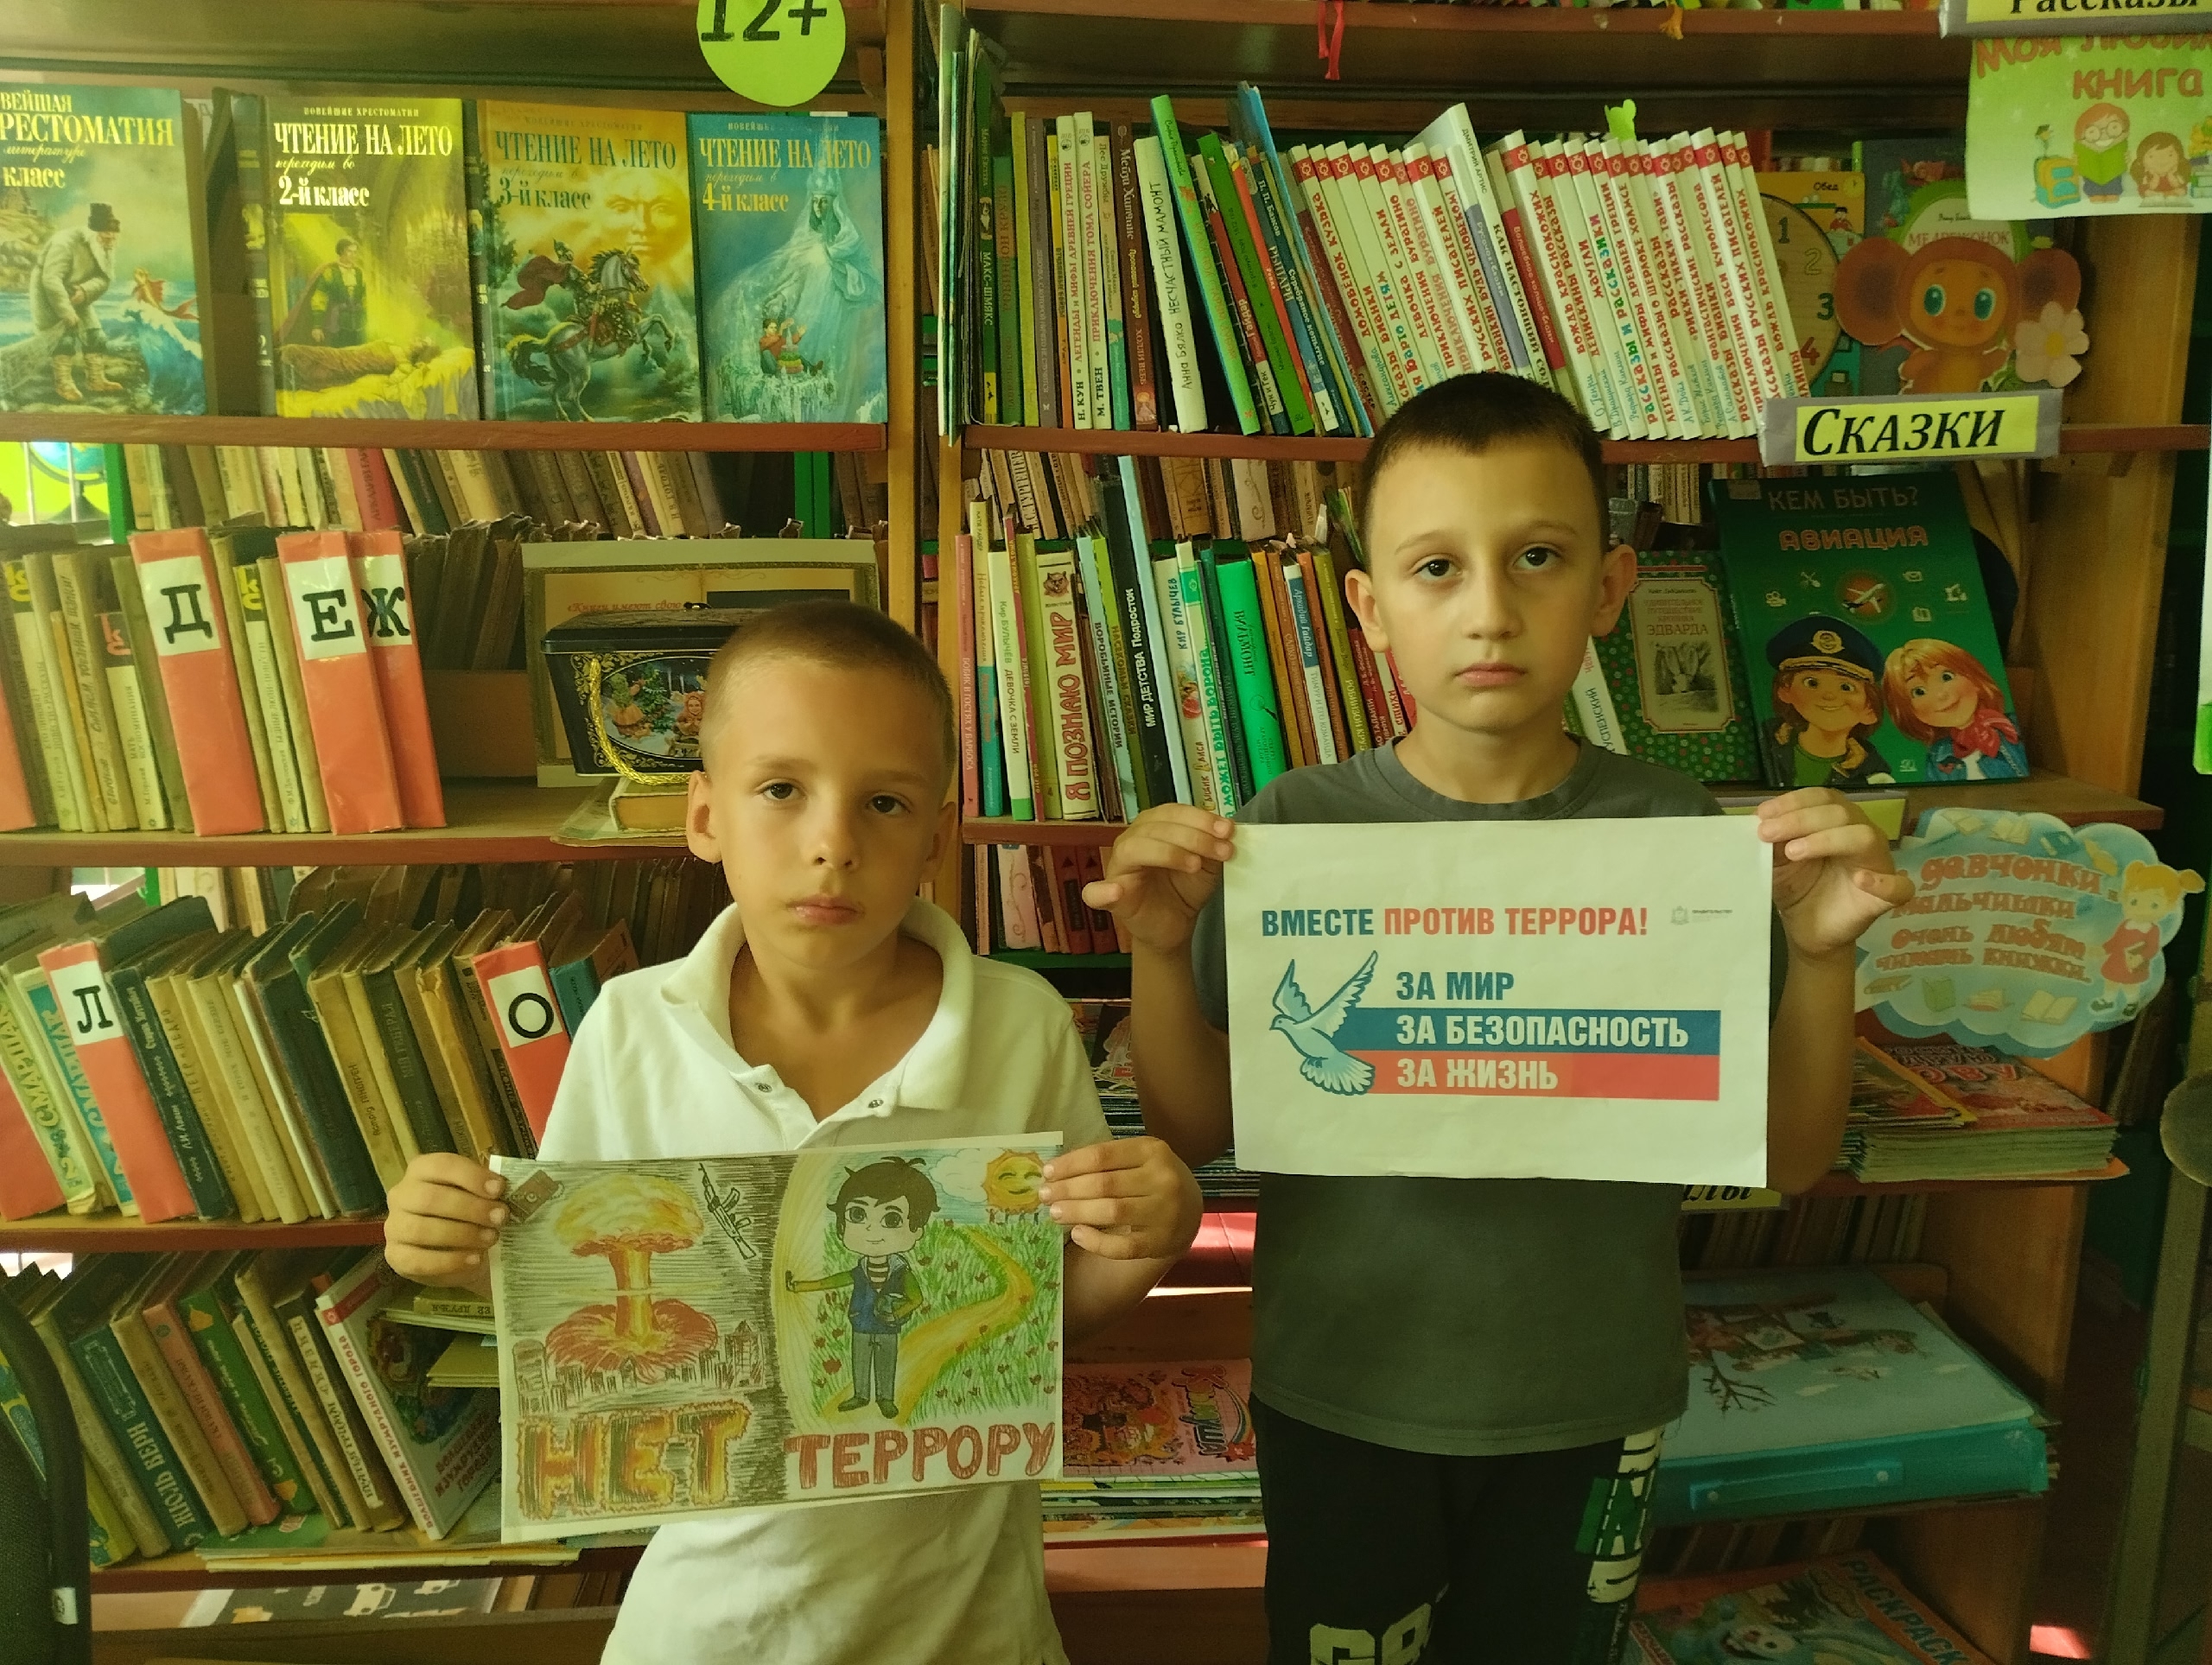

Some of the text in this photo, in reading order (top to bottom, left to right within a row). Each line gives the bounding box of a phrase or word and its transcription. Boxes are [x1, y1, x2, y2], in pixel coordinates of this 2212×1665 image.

[701, 0, 828, 41] 12+
[0, 89, 72, 112] ВЕЙШАЯ
[0, 112, 174, 146] РЕСТОМАТИЯ
[274, 123, 452, 156] ЧТЕНИЕ НА ЛЕТО
[496, 131, 676, 169] ЧТЕНИЕ НА ЛЕТО
[699, 137, 871, 168] ЧТЕНИЕ НА ЛЕТО
[1461, 127, 1480, 166] ДМИТРИЙ
[3, 167, 65, 187] класс
[279, 175, 369, 207] 2-й класс
[499, 176, 590, 210] 3-й класс
[702, 182, 789, 213] 4-й класс
[1813, 181, 1840, 191] Обед
[1265, 204, 1282, 236] Бажов
[1692, 181, 1724, 266] КУРОЛЕСОВА
[1777, 217, 1791, 245] 1
[1528, 188, 1586, 355] ВОЖДЬ КРАСНОКОЖИХ
[1577, 238, 1604, 301] МАУГЛИ
[1665, 179, 1722, 360] ФАНТАСТИЧЕСКИЕ РАССКАЗЫ
[1709, 173, 1761, 327] РУССКИХ ПИСАТЕЛЕЙ
[1735, 188, 1784, 352] ВОЖДЬ КРАСНОКОЖИХ
[1803, 247, 1823, 276] 2
[982, 251, 993, 326] МАКС-ШМЯКС
[1063, 162, 1084, 405] КУН ЛЕГЕНДЫ МИФЫ ДРЕВНЕЙ ГРЕЦИИ
[1081, 161, 1103, 398] ТВЕН ПРИКЛЮЧЕНИЯ ТОМА СОЙЕРА
[1147, 180, 1192, 390] Анна Бялко НЕСЧАСТНЫЙ МАМОНТ
[1286, 267, 1312, 324] Серебряное
[1389, 194, 1455, 368] ПРИКЛЮЧЕНИЯ БУРАТИНО
[1431, 204, 1492, 361] РУССКИХ ПИСАТЕЛЕЙ
[1541, 194, 1599, 358] ДЕНИСКИНЫ РАССКАЗЫ
[1618, 181, 1681, 377] РАССКАЗЫ ШЕРЛОКЕ ХОЛМСЕ
[1649, 236, 1681, 318] РАССКАЗЫ
[1236, 297, 1257, 337] Гайдар
[1599, 181, 1676, 423] ЛЕГЕНДЫ МИФЫ ДРЕВНЕЙ ГРЕЦИИ
[1817, 293, 1834, 320] 3
[1704, 281, 1751, 422] РАССКАЗЫ БИАНКИ
[1800, 336, 1821, 365] 4
[1803, 408, 2006, 456] СКАЗКИ
[1768, 486, 1920, 512] КЕМ БЫТЬ?
[1779, 524, 1929, 551] АВИАЦИЯ
[161, 583, 213, 644] Д
[302, 588, 355, 641] Е
[361, 586, 411, 638] Ж
[976, 573, 988, 663] Новые приключения
[1166, 577, 1187, 650] КИР БУЛЫЧЕВ
[1293, 588, 1314, 658] Аркадий Гайдар
[1647, 624, 1709, 637] ЭДВАРДА
[1123, 587, 1156, 727] МИР ДЕТСТВА Подросток
[1232, 610, 1255, 678] ВИЛЬМОНТ
[962, 658, 970, 683] БОБИК
[996, 601, 1019, 754] Кир БУЛЫЧЁВ ДЕВОЧКА ЗЕМЛИ
[1094, 620, 1123, 748] ВОРОБЬИНЫЕ ИСТОРИИ
[963, 694, 971, 723] ГОСТЯХ
[1049, 609, 1090, 802] Я ПОЗНАЮ МИР
[1122, 693, 1136, 734] СКАЗКИ
[1309, 670, 1332, 758] ТИМУР КОМАНДА
[1344, 678, 1363, 727] РОБИНЗОН
[1208, 709, 1233, 806] МОЖЕТ БЫТЬ
[1262, 907, 1648, 937] ВМЕСТЕ ПРОТИВ ТЕРРОРА!
[73, 985, 114, 1034] Л
[1396, 972, 1515, 1001] ЗА МИР
[508, 992, 555, 1039] О
[1397, 1016, 1689, 1048] ЗА БЕЗОПАСНОСТЬ
[1398, 1059, 1558, 1090] ЗА ЖИЗНЬ
[431, 1303, 471, 1314] ДРУЗЬЯ
[125, 1420, 166, 1471] ВЕРН
[336, 1334, 434, 1529] ВОЛШЕБНИК ИЗУМРУДНОГО ГОРОДА
[519, 1401, 751, 1520] НЕТ
[785, 1422, 1055, 1489] ТЕРРОРУ
[150, 1467, 197, 1529] ЖЮЛЬ
